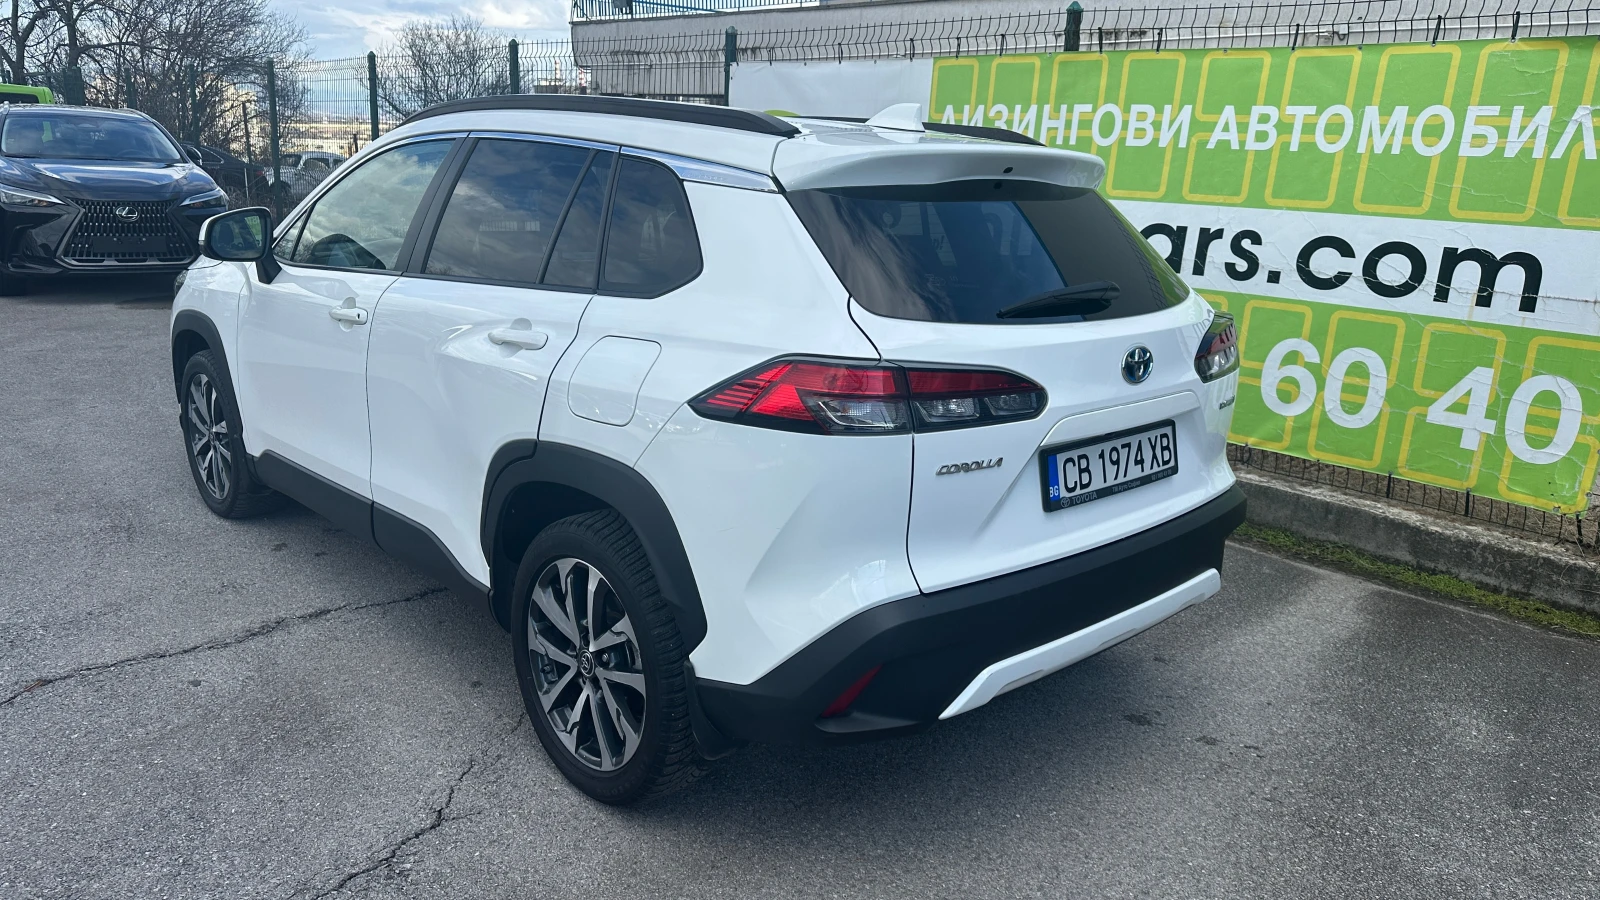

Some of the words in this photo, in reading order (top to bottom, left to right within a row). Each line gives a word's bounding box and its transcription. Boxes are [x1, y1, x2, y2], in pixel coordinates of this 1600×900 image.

[1206, 103, 1598, 160] АВТОМОБИЛ
[1260, 337, 1388, 429] 60
[1426, 366, 1583, 465] 40
[935, 457, 1003, 476] COROLLA
[1098, 439, 1145, 484] 1974
[1049, 485, 1059, 498] BG
[1071, 491, 1098, 505] TOYOTA
